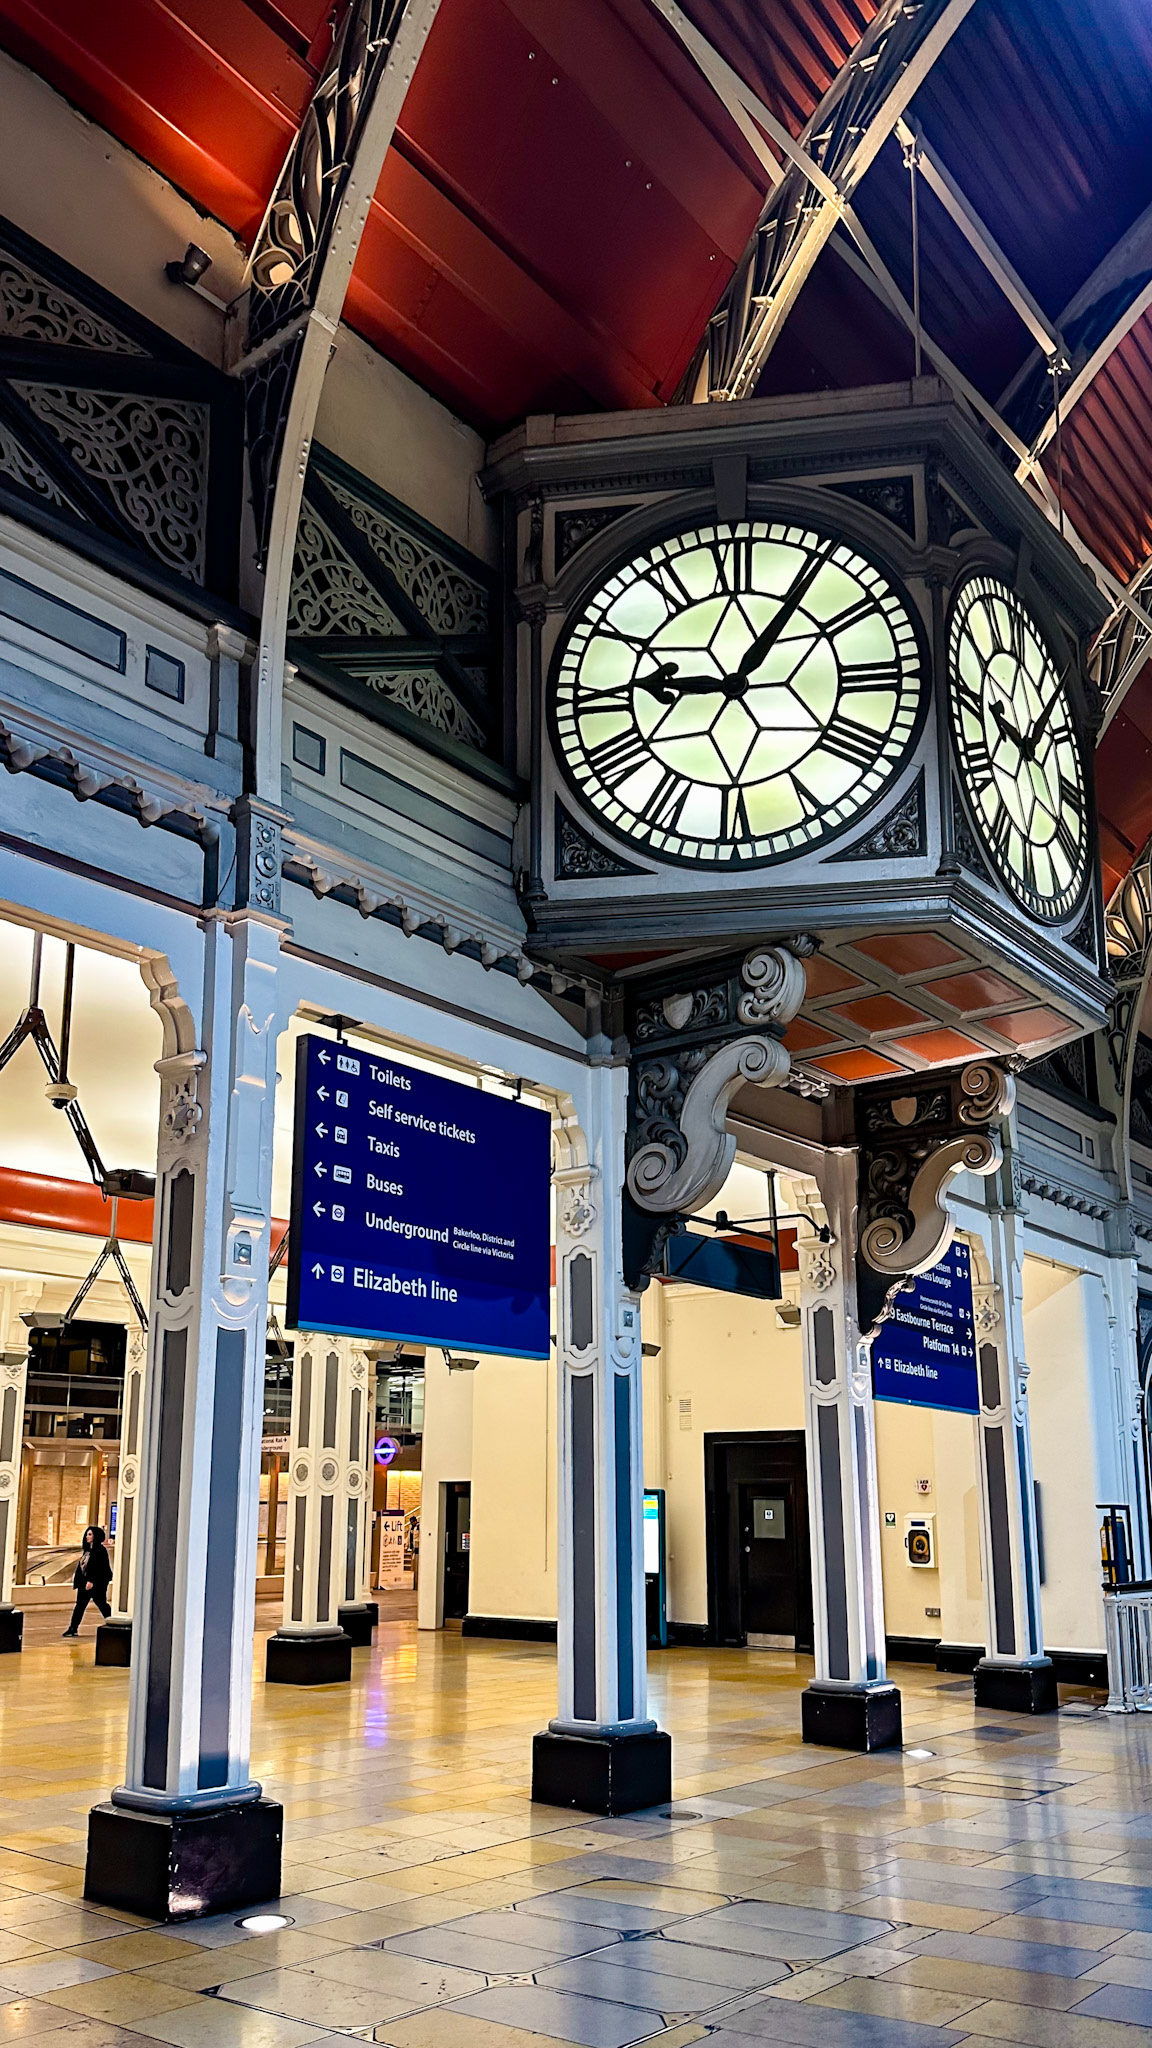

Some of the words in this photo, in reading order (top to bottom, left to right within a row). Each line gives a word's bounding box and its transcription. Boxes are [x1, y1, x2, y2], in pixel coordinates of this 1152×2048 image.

[369, 1064, 412, 1091] Toilets
[368, 1100, 393, 1120] Self
[394, 1111, 437, 1133] service
[438, 1121, 476, 1144] tickets
[367, 1135, 400, 1158] Taxis
[366, 1173, 403, 1196] Buses
[365, 1211, 449, 1243] Underground
[453, 1226, 481, 1241] Bakerloo,
[482, 1233, 503, 1245] District
[503, 1239, 515, 1248] and
[452, 1240, 470, 1251] Circle
[470, 1243, 482, 1253] line
[482, 1247, 492, 1256] via
[492, 1248, 514, 1260] Victoria
[353, 1267, 427, 1298] Elizabeth
[431, 1280, 458, 1303] line
[932, 1272, 952, 1288] Lounge
[896, 1308, 931, 1329] Eastbourne
[931, 1317, 954, 1335] Terrace
[922, 1335, 951, 1354] Platform
[951, 1343, 960, 1356] 14
[893, 1358, 926, 1378] Elizabeth
[925, 1364, 939, 1380] line
[391, 1520, 403, 1532] Lift
